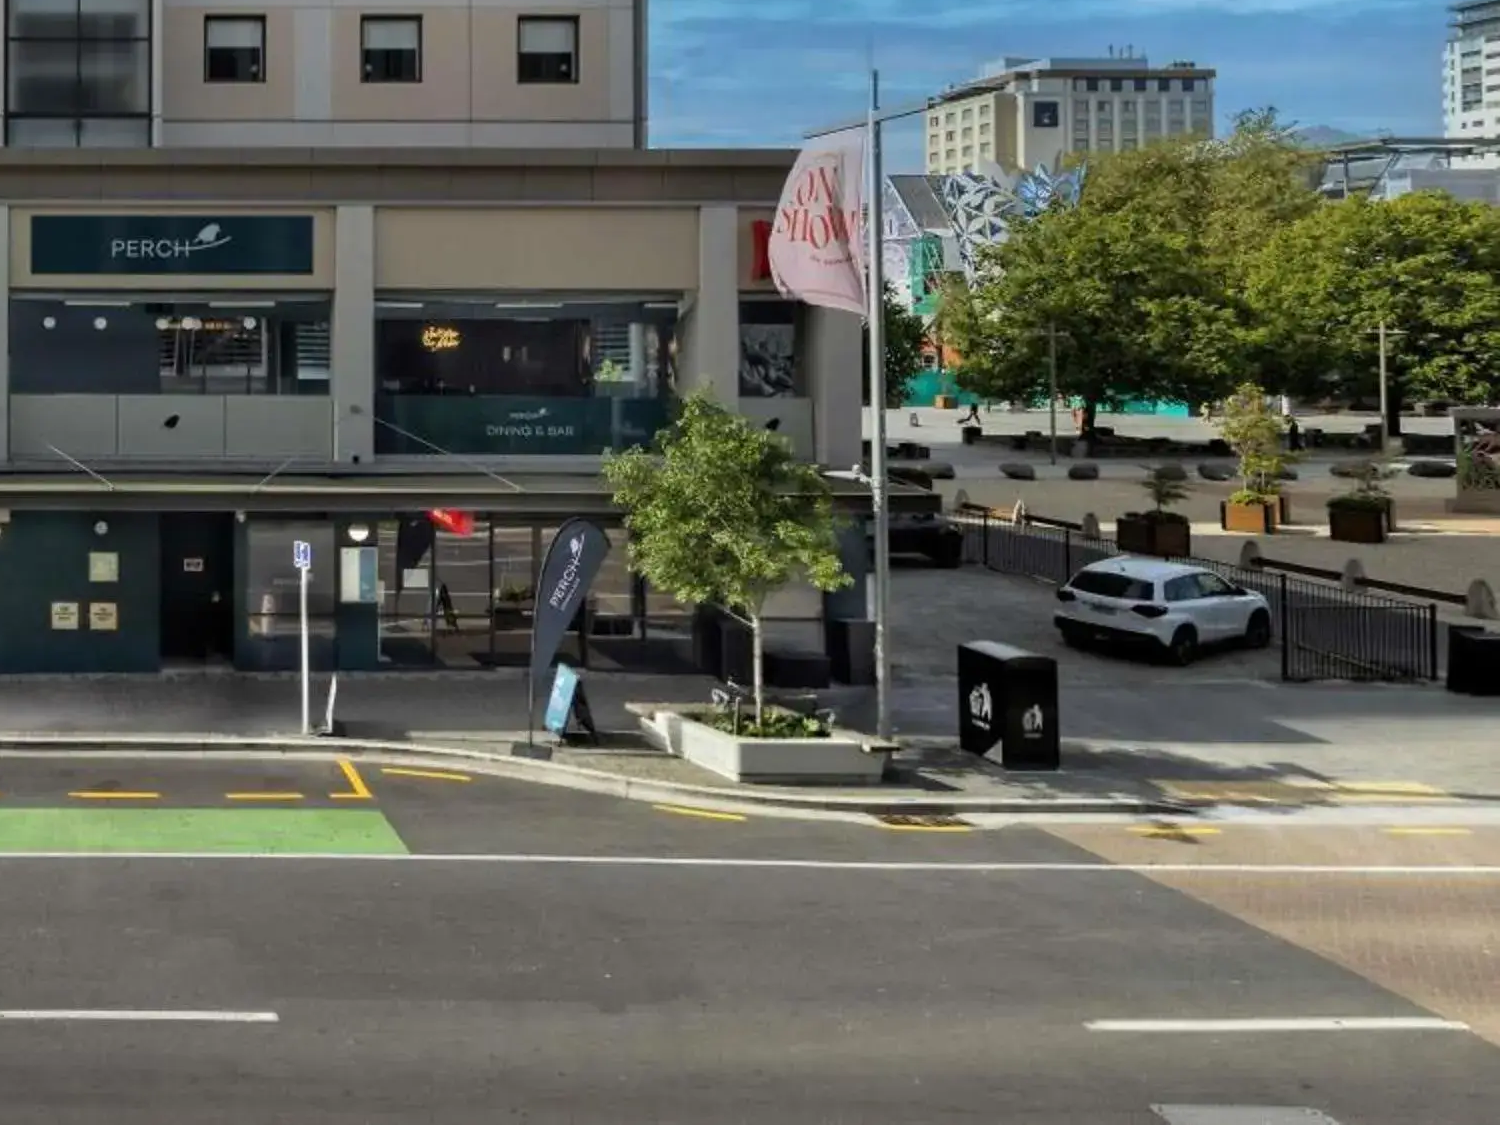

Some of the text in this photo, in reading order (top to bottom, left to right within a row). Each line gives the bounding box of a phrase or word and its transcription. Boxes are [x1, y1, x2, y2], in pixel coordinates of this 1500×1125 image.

[794, 165, 838, 206] ON
[777, 200, 856, 249] SHOW
[111, 239, 190, 258] PERCH
[486, 425, 533, 436] DINING
[550, 558, 582, 610] PERCH
